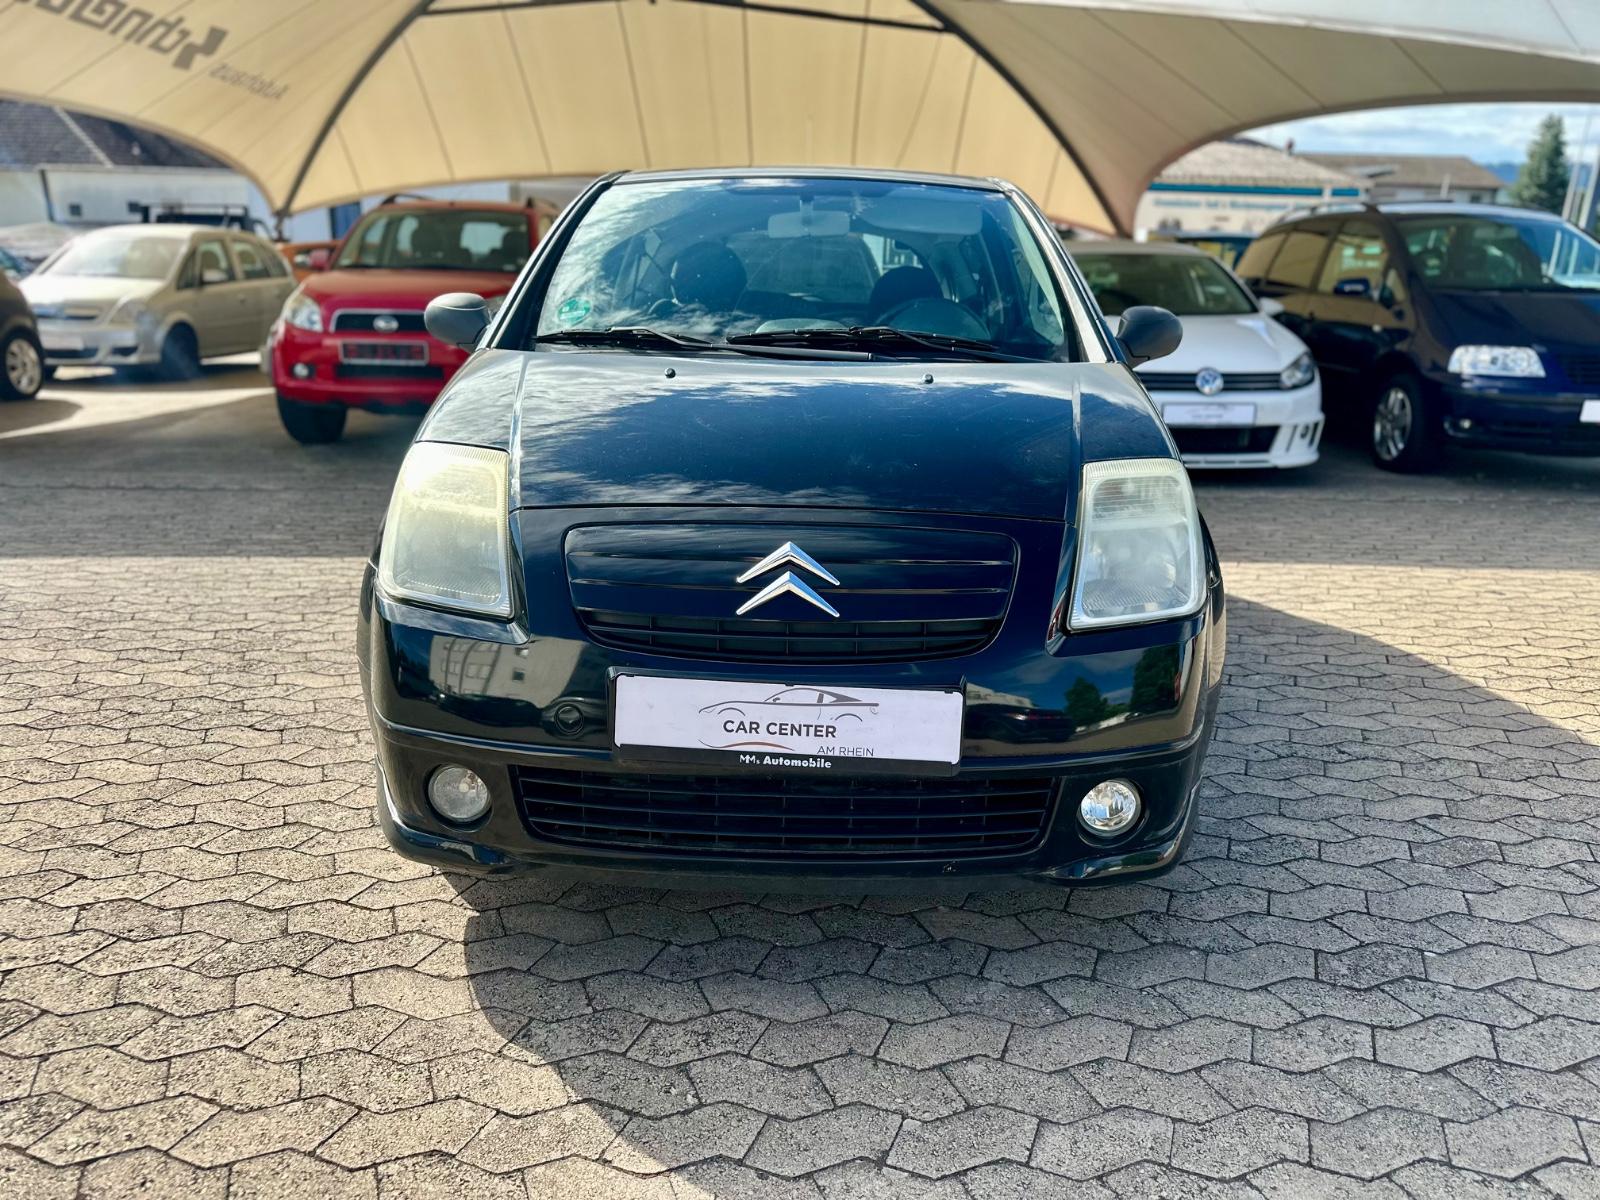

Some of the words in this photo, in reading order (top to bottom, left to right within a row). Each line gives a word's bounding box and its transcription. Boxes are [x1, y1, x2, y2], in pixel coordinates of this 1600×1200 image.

[723, 719, 761, 735] CAR
[765, 722, 837, 738] CENTER
[816, 745, 836, 755] AM
[839, 746, 874, 757] RHEIN
[762, 755, 832, 768] Automobile
